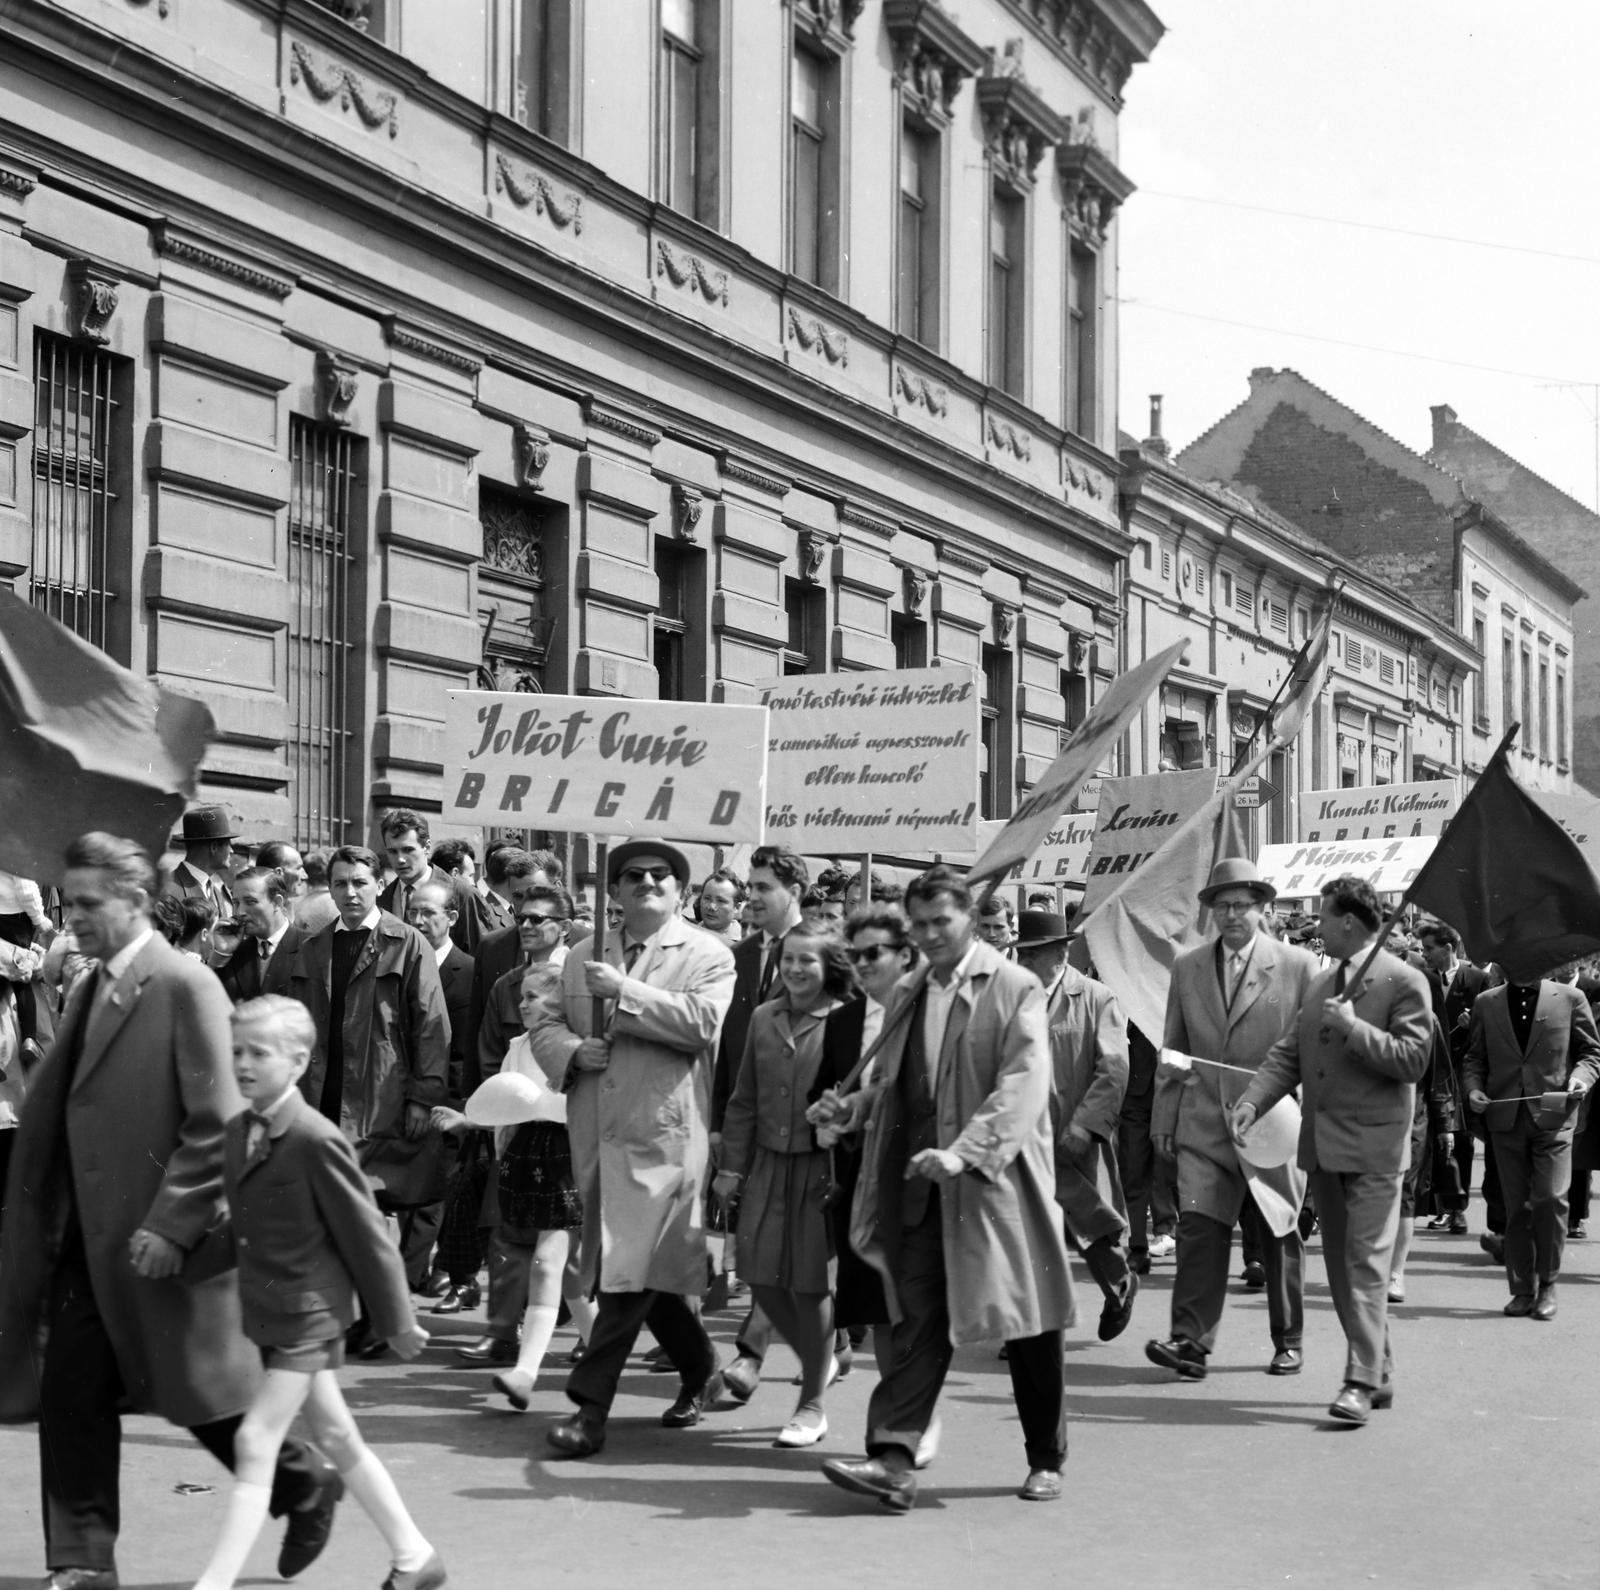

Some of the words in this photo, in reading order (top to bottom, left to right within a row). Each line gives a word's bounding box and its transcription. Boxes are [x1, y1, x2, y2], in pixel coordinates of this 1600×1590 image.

[880, 680, 973, 706] üdvözlet
[468, 703, 593, 760] Joliot
[599, 711, 707, 768] Curie
[768, 738, 779, 752] z
[780, 732, 861, 751] amerikai
[865, 729, 970, 753] agresszorok
[804, 764, 856, 786] ellen
[857, 761, 928, 785] harcoló
[454, 772, 742, 825] BRIGÁD
[1319, 799, 1379, 820] Kandó
[1383, 792, 1450, 814] Kálmán
[804, 807, 892, 827] vietnami
[895, 802, 976, 831] népnek!
[1101, 803, 1180, 833] Lenin
[1091, 852, 1155, 876] BRI
[1284, 846, 1378, 868] Május
